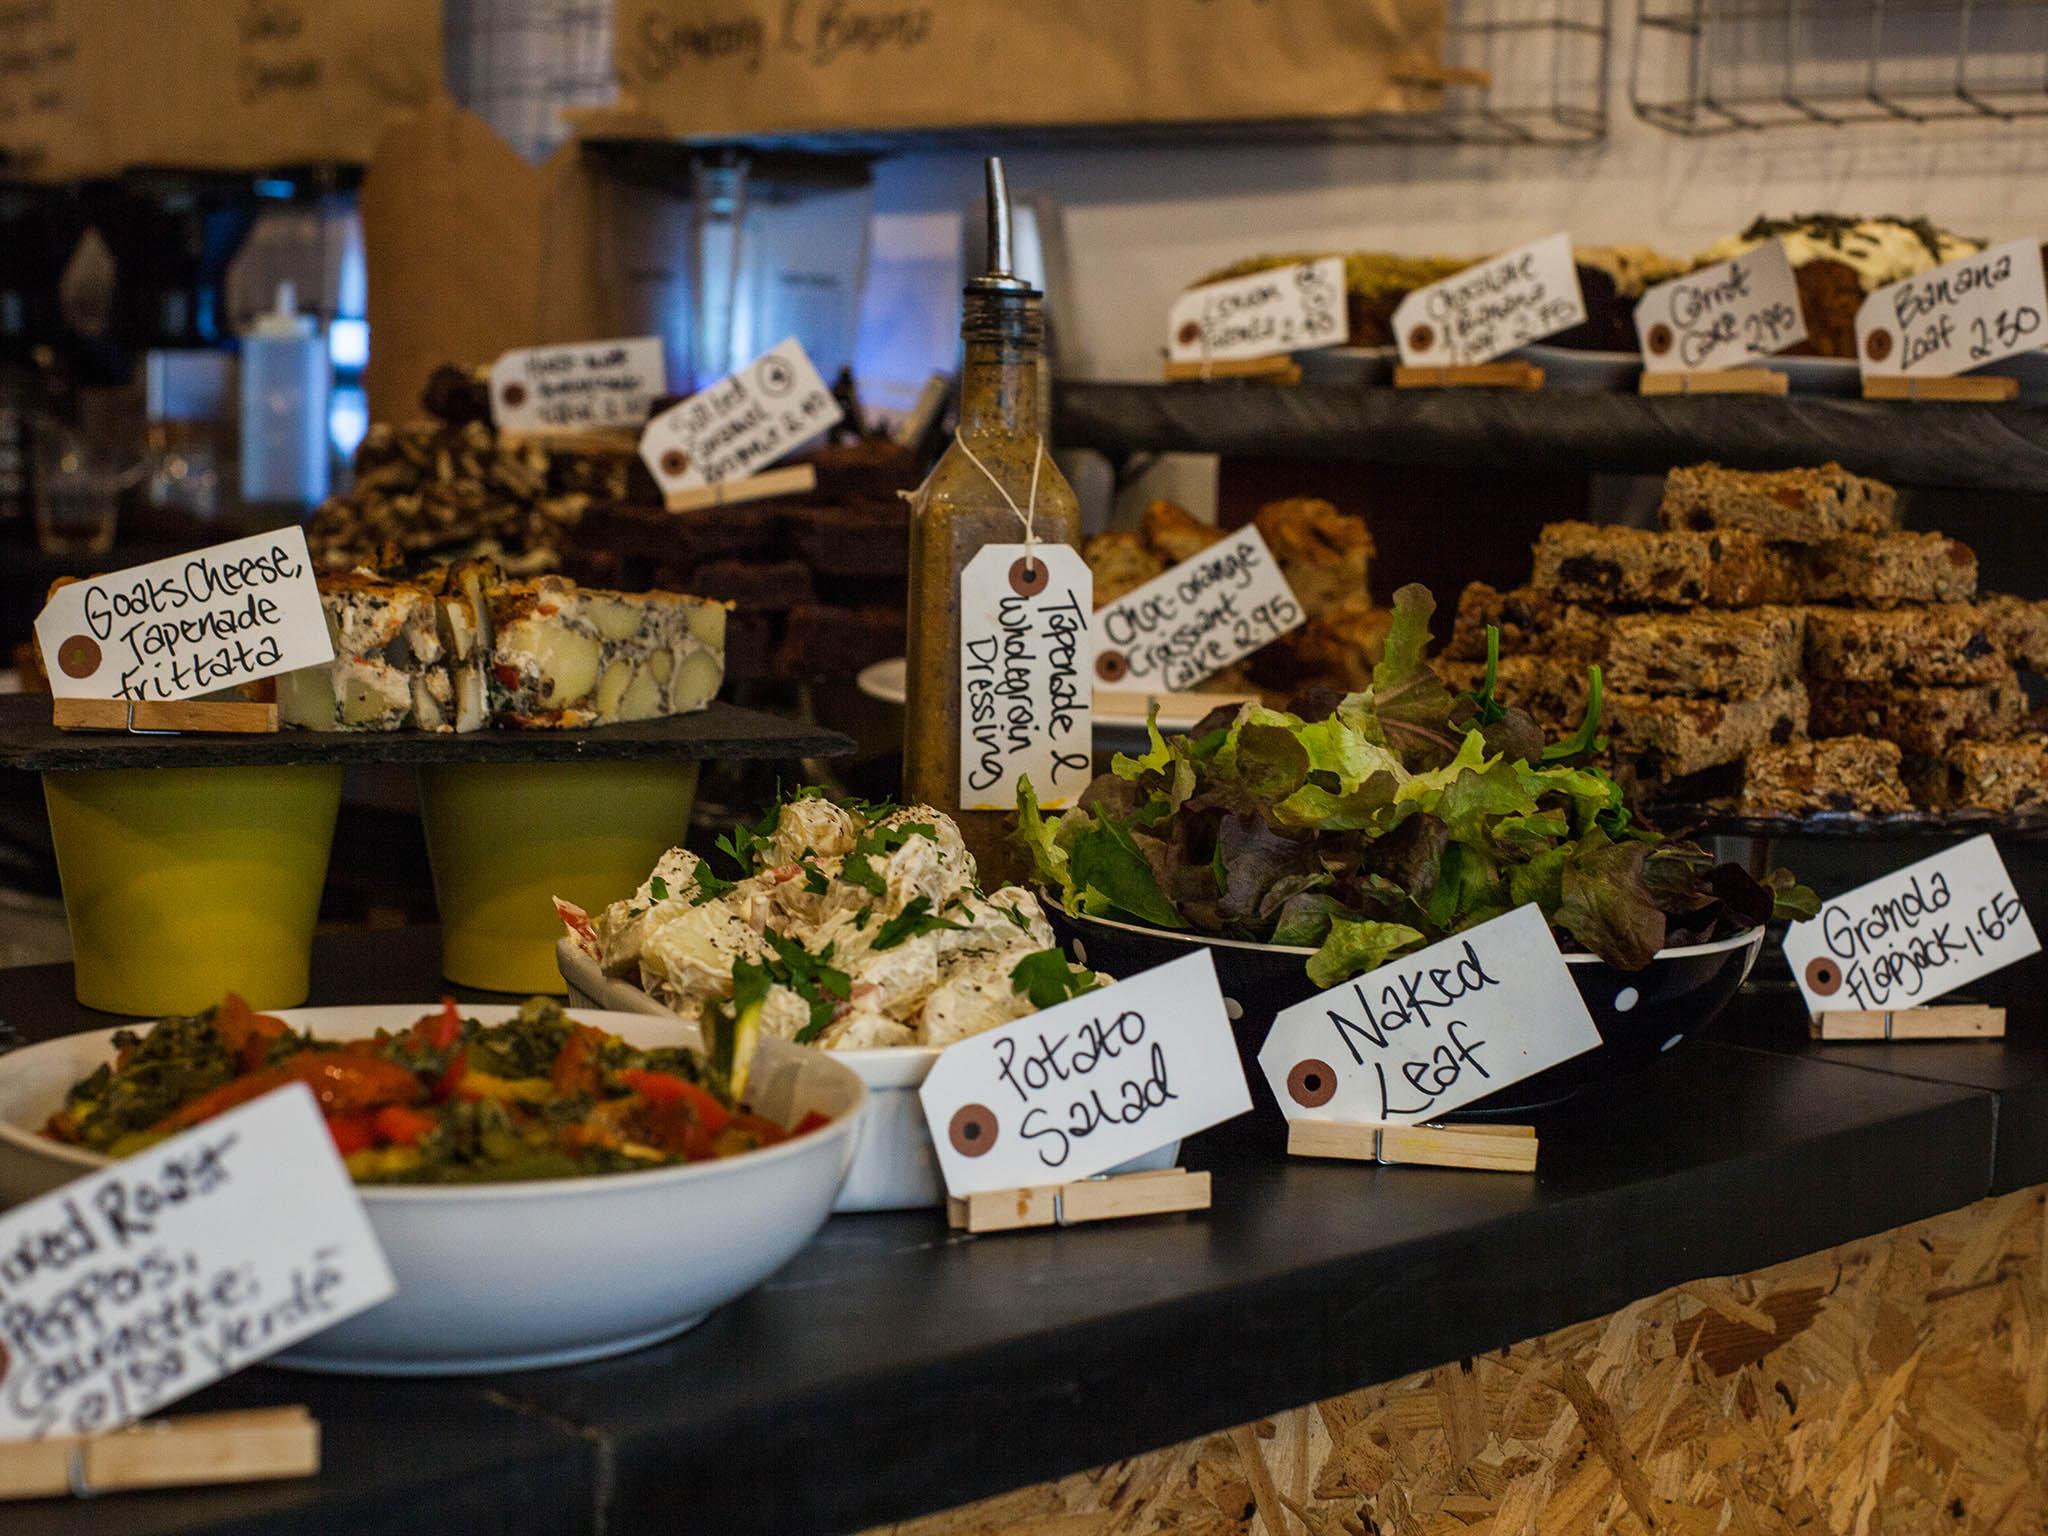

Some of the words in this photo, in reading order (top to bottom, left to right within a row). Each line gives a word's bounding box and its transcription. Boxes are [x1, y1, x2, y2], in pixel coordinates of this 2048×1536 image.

[1893, 254, 2012, 331] Banana
[1902, 313, 1956, 371] Loaf
[120, 593, 281, 666] Tapenade
[1038, 588, 1090, 742] Tapenade
[966, 635, 1005, 792] Dressing
[1823, 872, 1951, 959] Granola
[1326, 939, 1501, 1065] Naked
[993, 1009, 1148, 1103] Potato
[1375, 1020, 1492, 1121] Leaf
[1019, 1042, 1179, 1168] Salad
